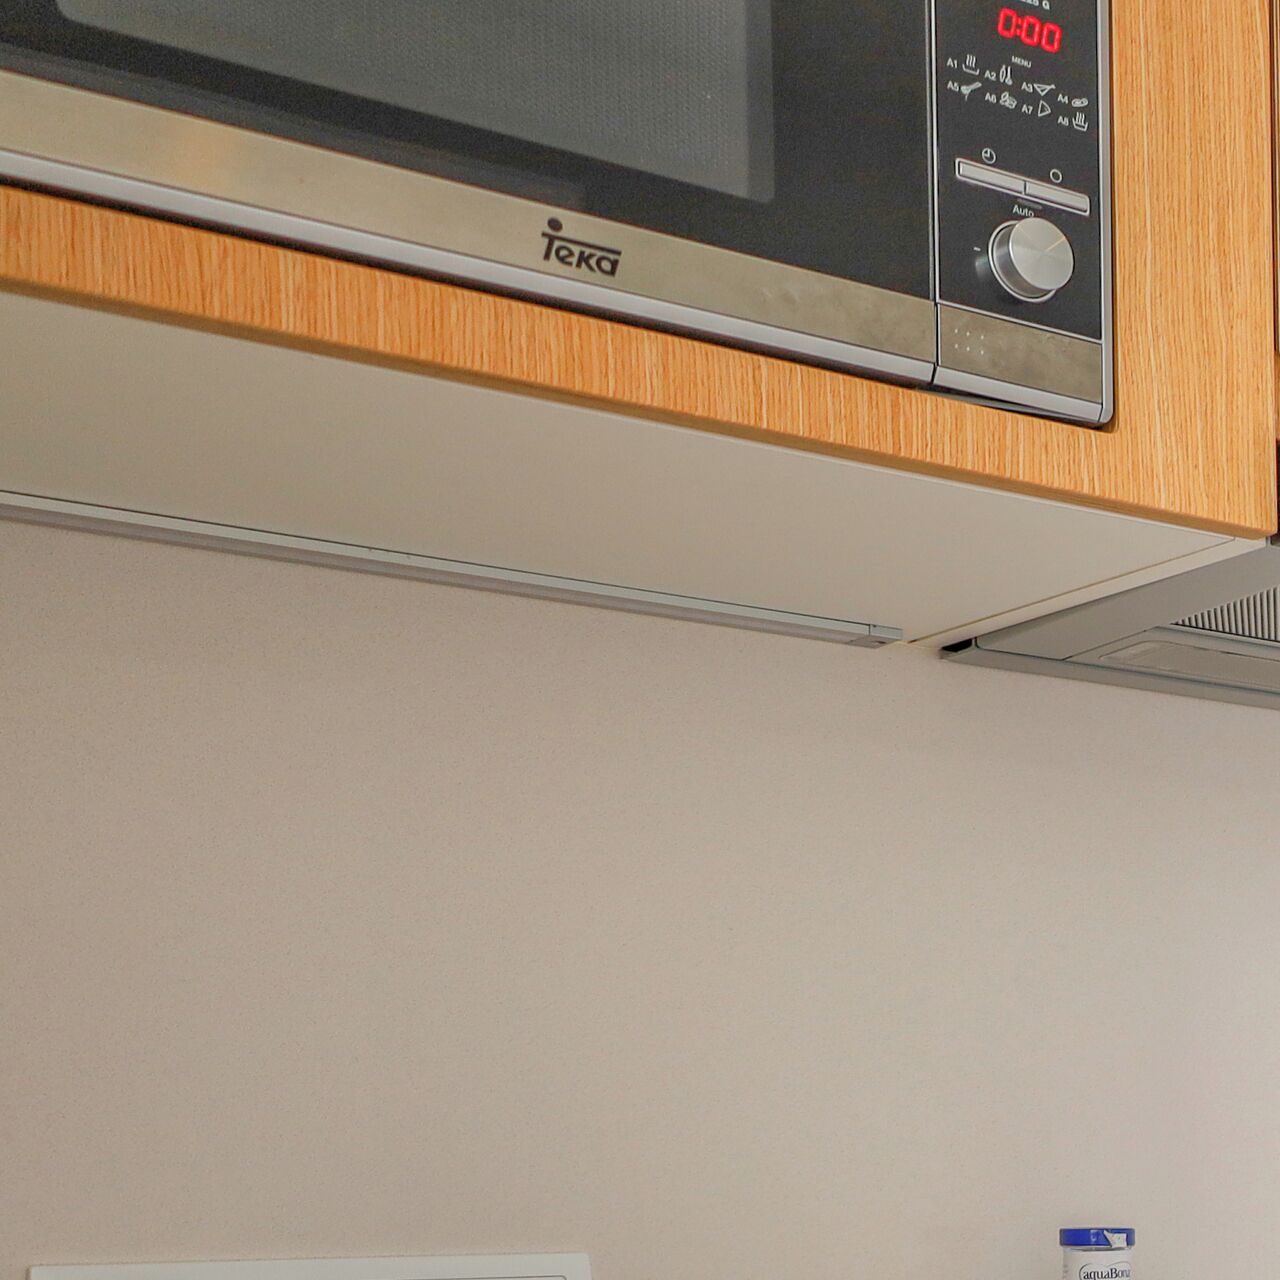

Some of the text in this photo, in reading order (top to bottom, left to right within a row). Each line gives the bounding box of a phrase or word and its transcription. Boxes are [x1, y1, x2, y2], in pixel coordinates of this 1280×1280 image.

[997, 8, 1062, 53] 0:00
[947, 58, 958, 68] A1
[1011, 55, 1032, 68] MENU
[984, 70, 997, 81] A2
[1021, 82, 1033, 93] A3
[1057, 93, 1069, 104] A4
[1021, 104, 1033, 115] A7
[1012, 204, 1035, 218] Auto
